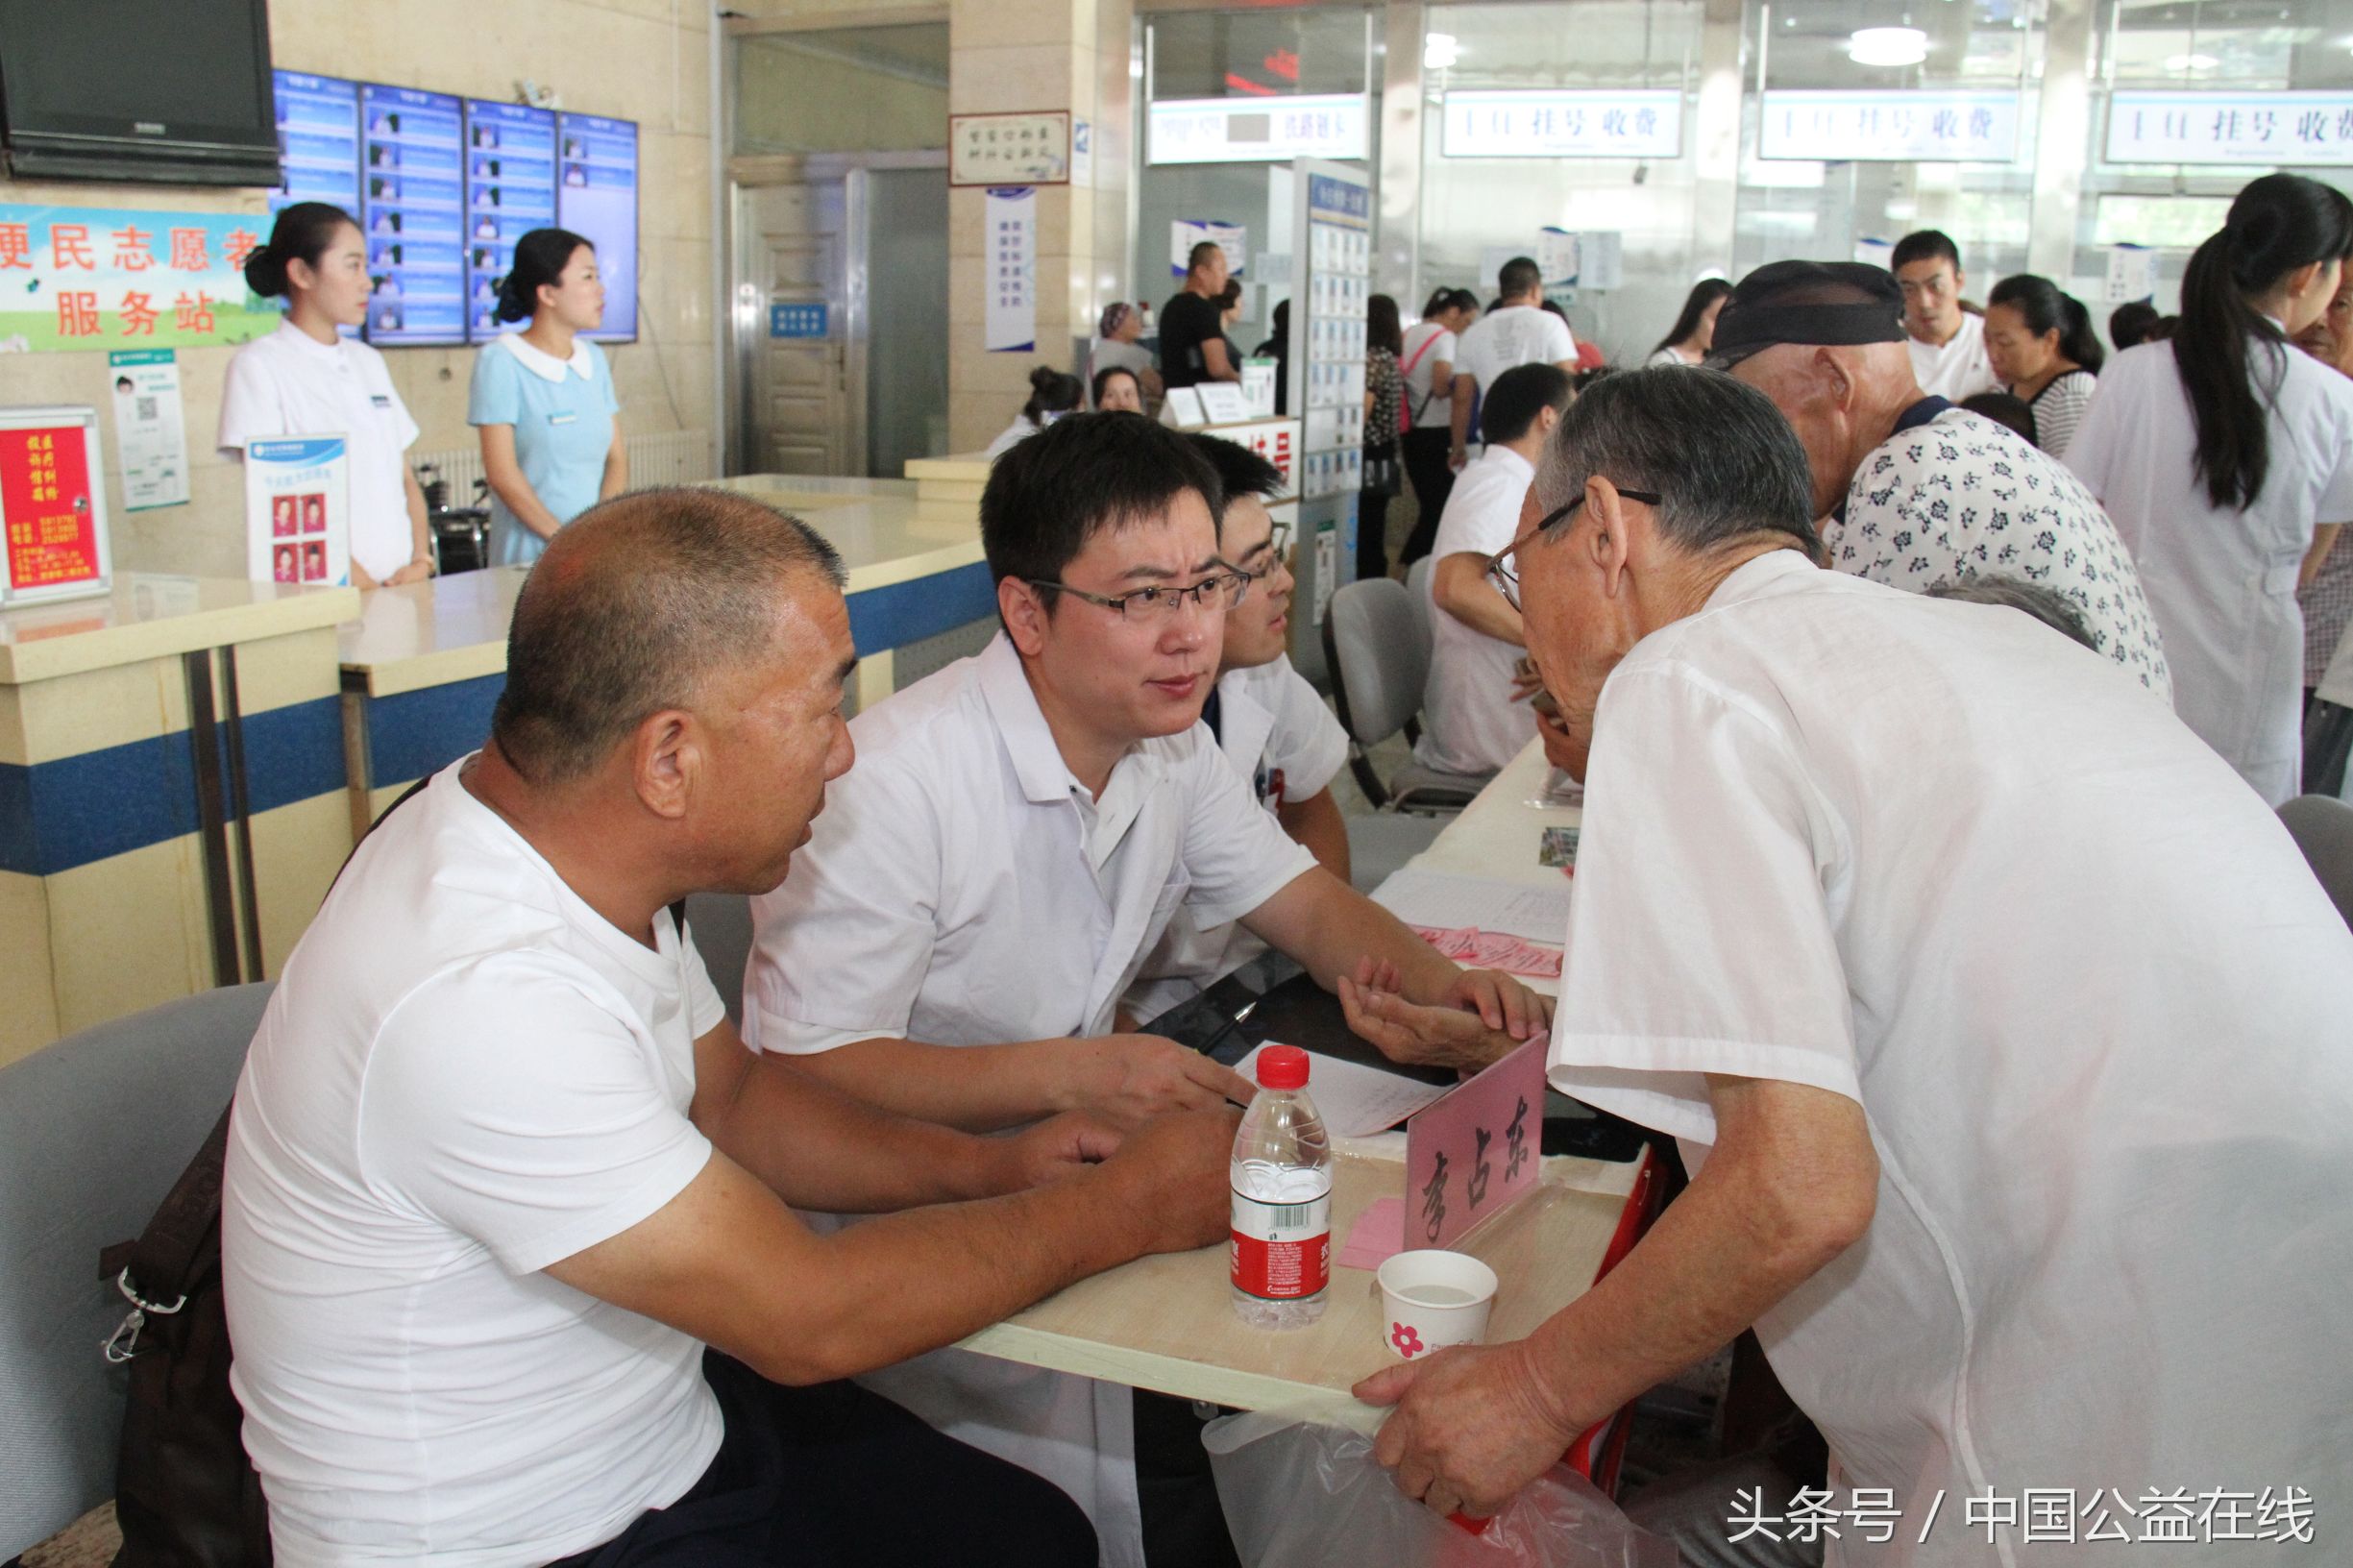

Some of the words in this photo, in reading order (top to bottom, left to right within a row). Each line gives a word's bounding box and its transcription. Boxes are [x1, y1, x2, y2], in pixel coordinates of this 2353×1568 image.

[0, 223, 257, 273] 便民志愿者
[57, 290, 214, 336] 服务站
